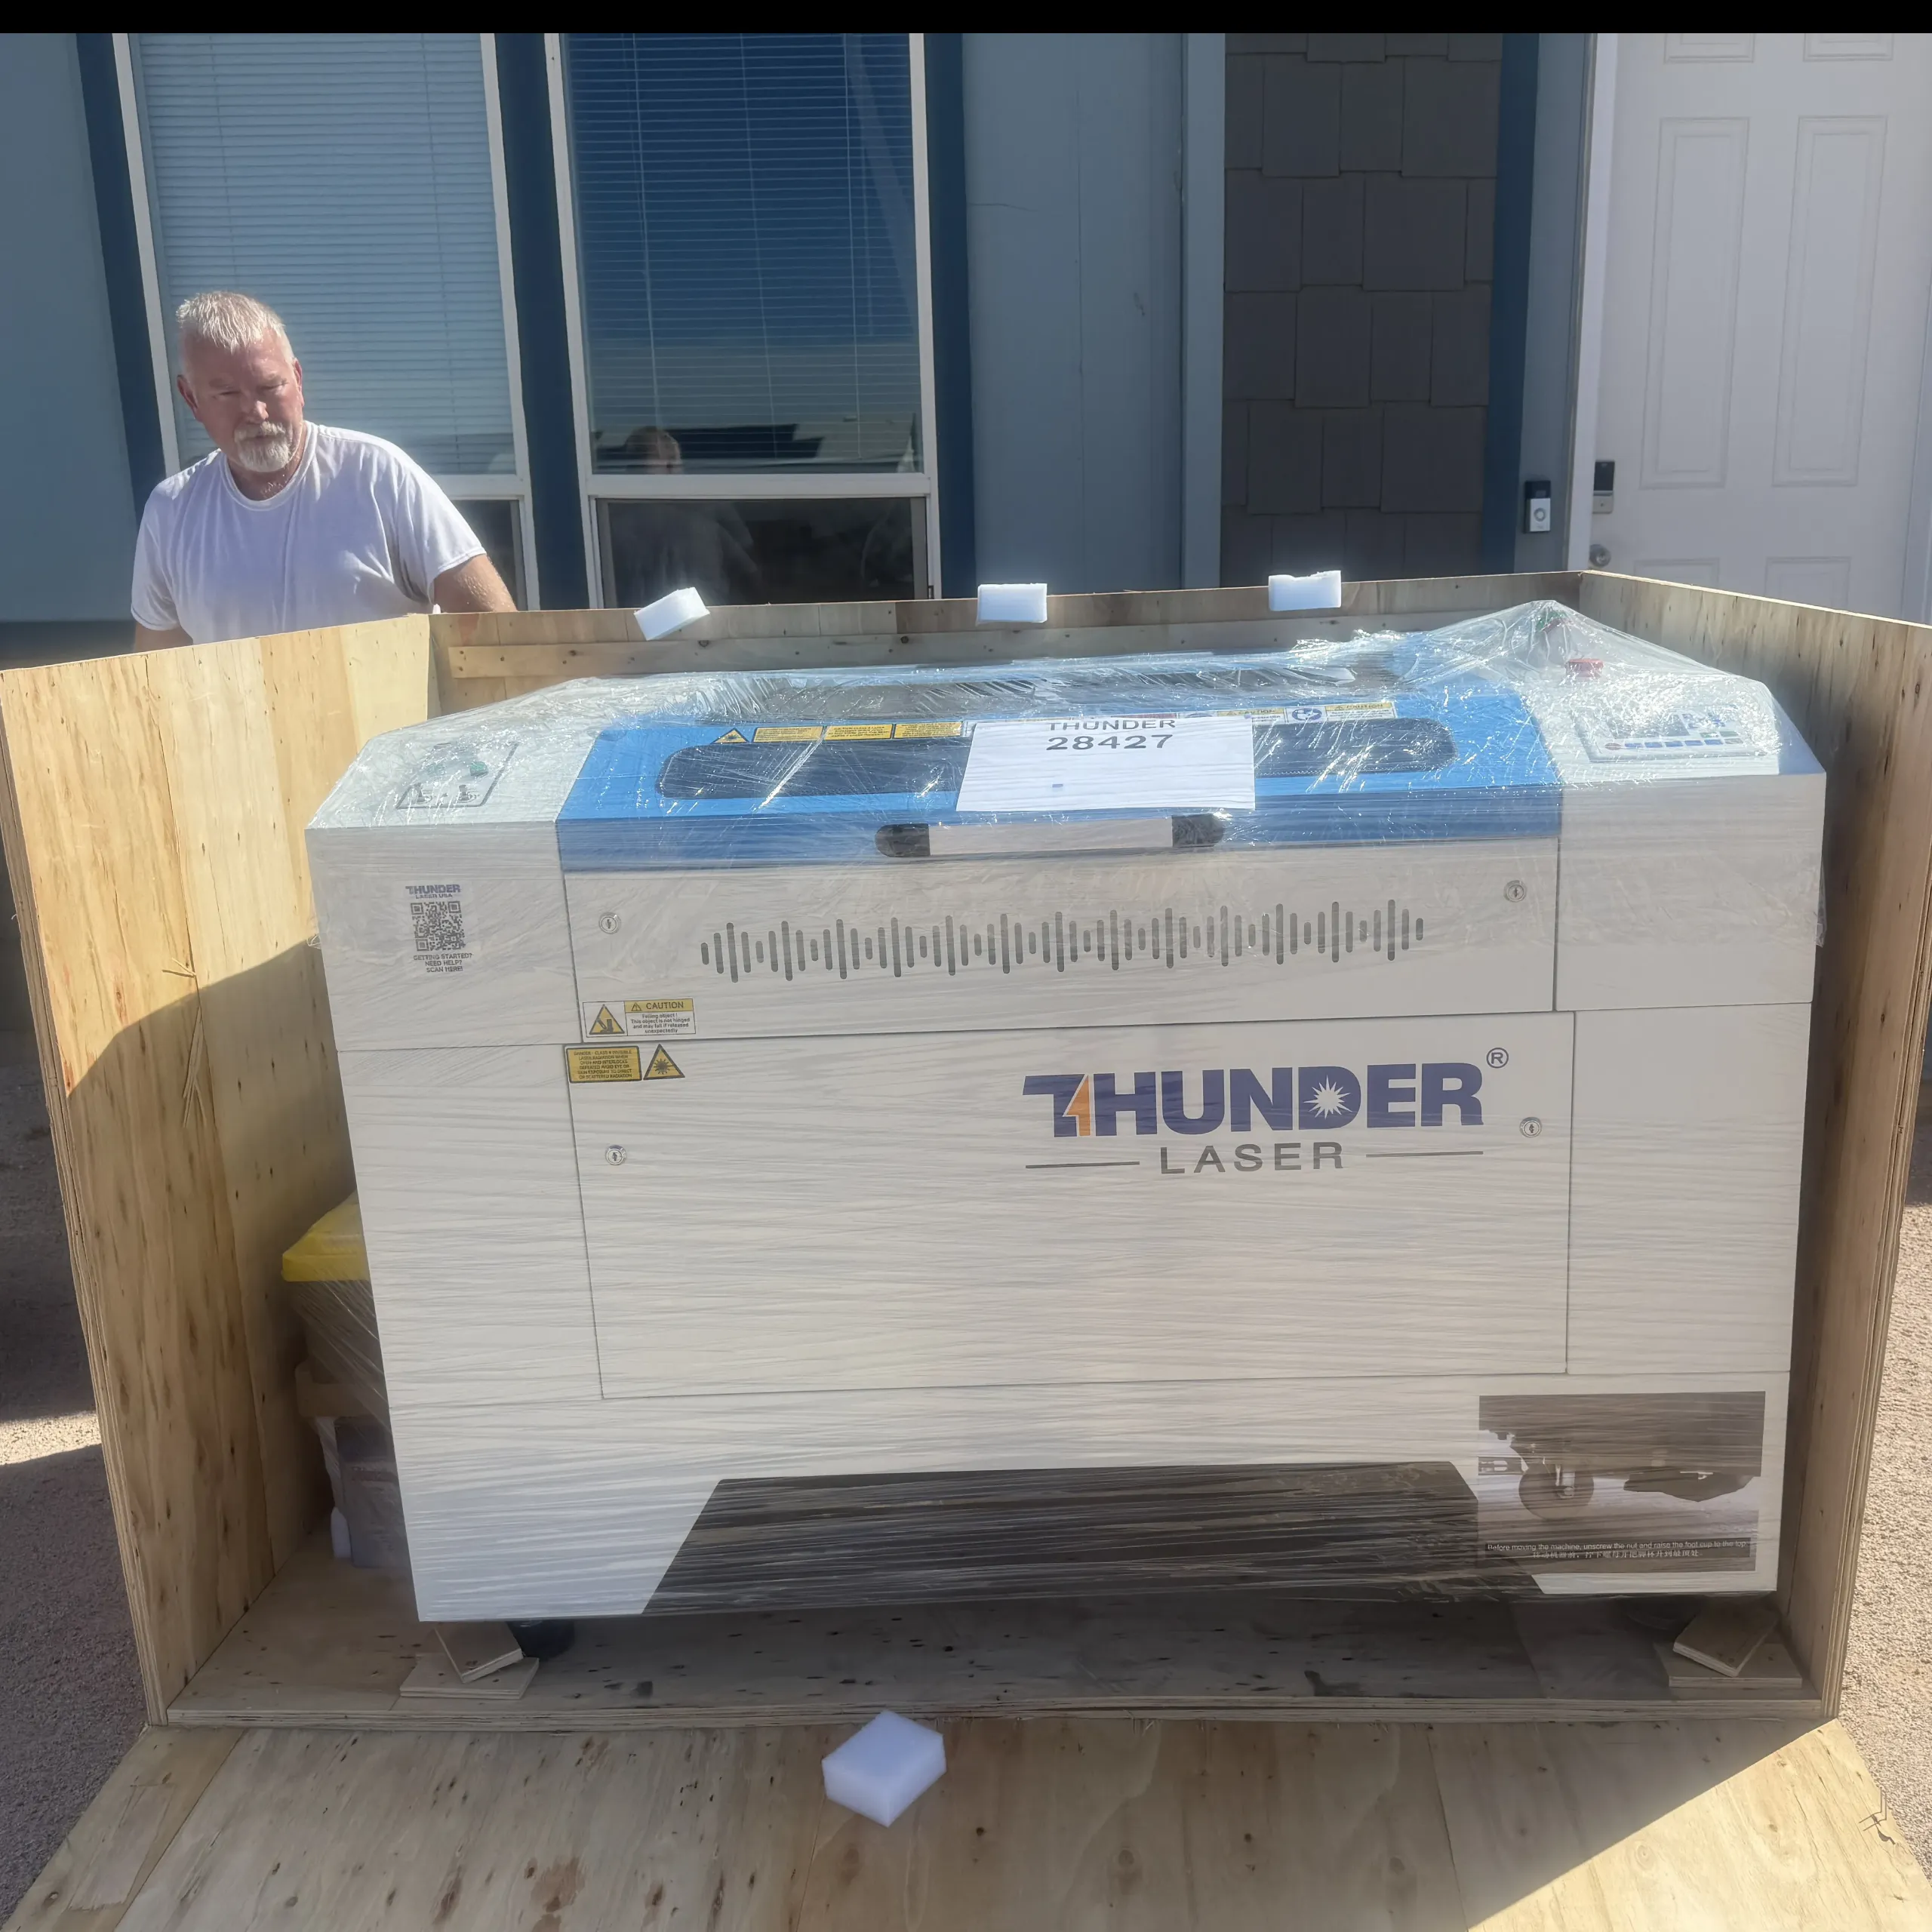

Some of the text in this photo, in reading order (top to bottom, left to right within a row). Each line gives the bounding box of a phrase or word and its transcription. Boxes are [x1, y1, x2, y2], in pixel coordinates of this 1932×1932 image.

[1050, 719, 1176, 731] THUNDER
[1046, 734, 1173, 750] 28427
[405, 884, 461, 894] THUNDER
[1023, 1063, 1484, 1137] THUNDER
[1160, 1142, 1343, 1174] LASER
